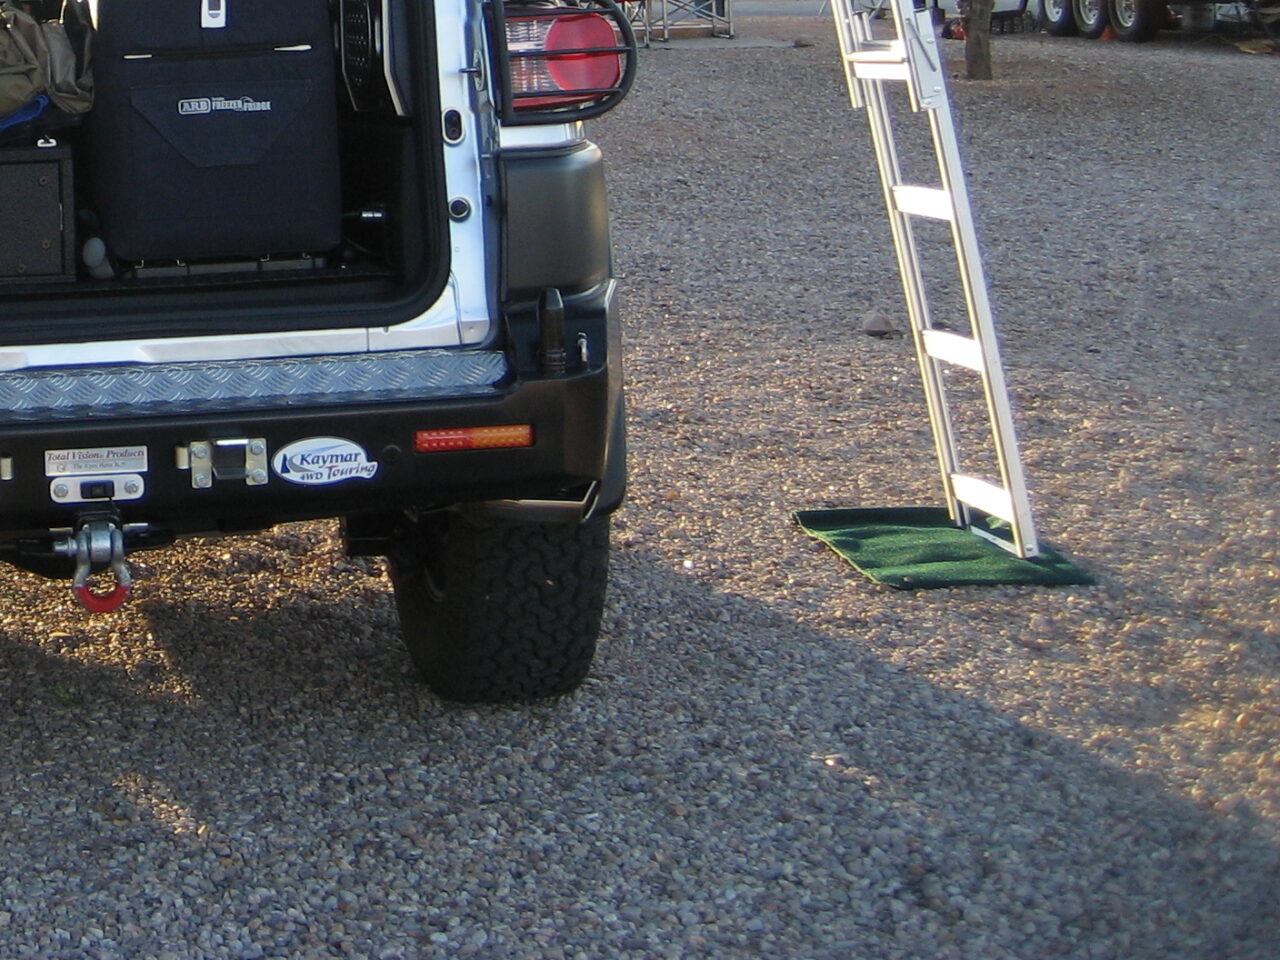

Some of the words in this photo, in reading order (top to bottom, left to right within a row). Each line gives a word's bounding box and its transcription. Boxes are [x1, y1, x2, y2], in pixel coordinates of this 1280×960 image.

[182, 101, 208, 112] ARB
[212, 100, 242, 110] FREEZER
[244, 101, 271, 111] FRIDGE
[47, 452, 69, 461] Total
[106, 449, 144, 458] Products
[300, 452, 361, 469] Kaymar
[300, 472, 323, 481] 4WD
[325, 463, 375, 480] Touring
